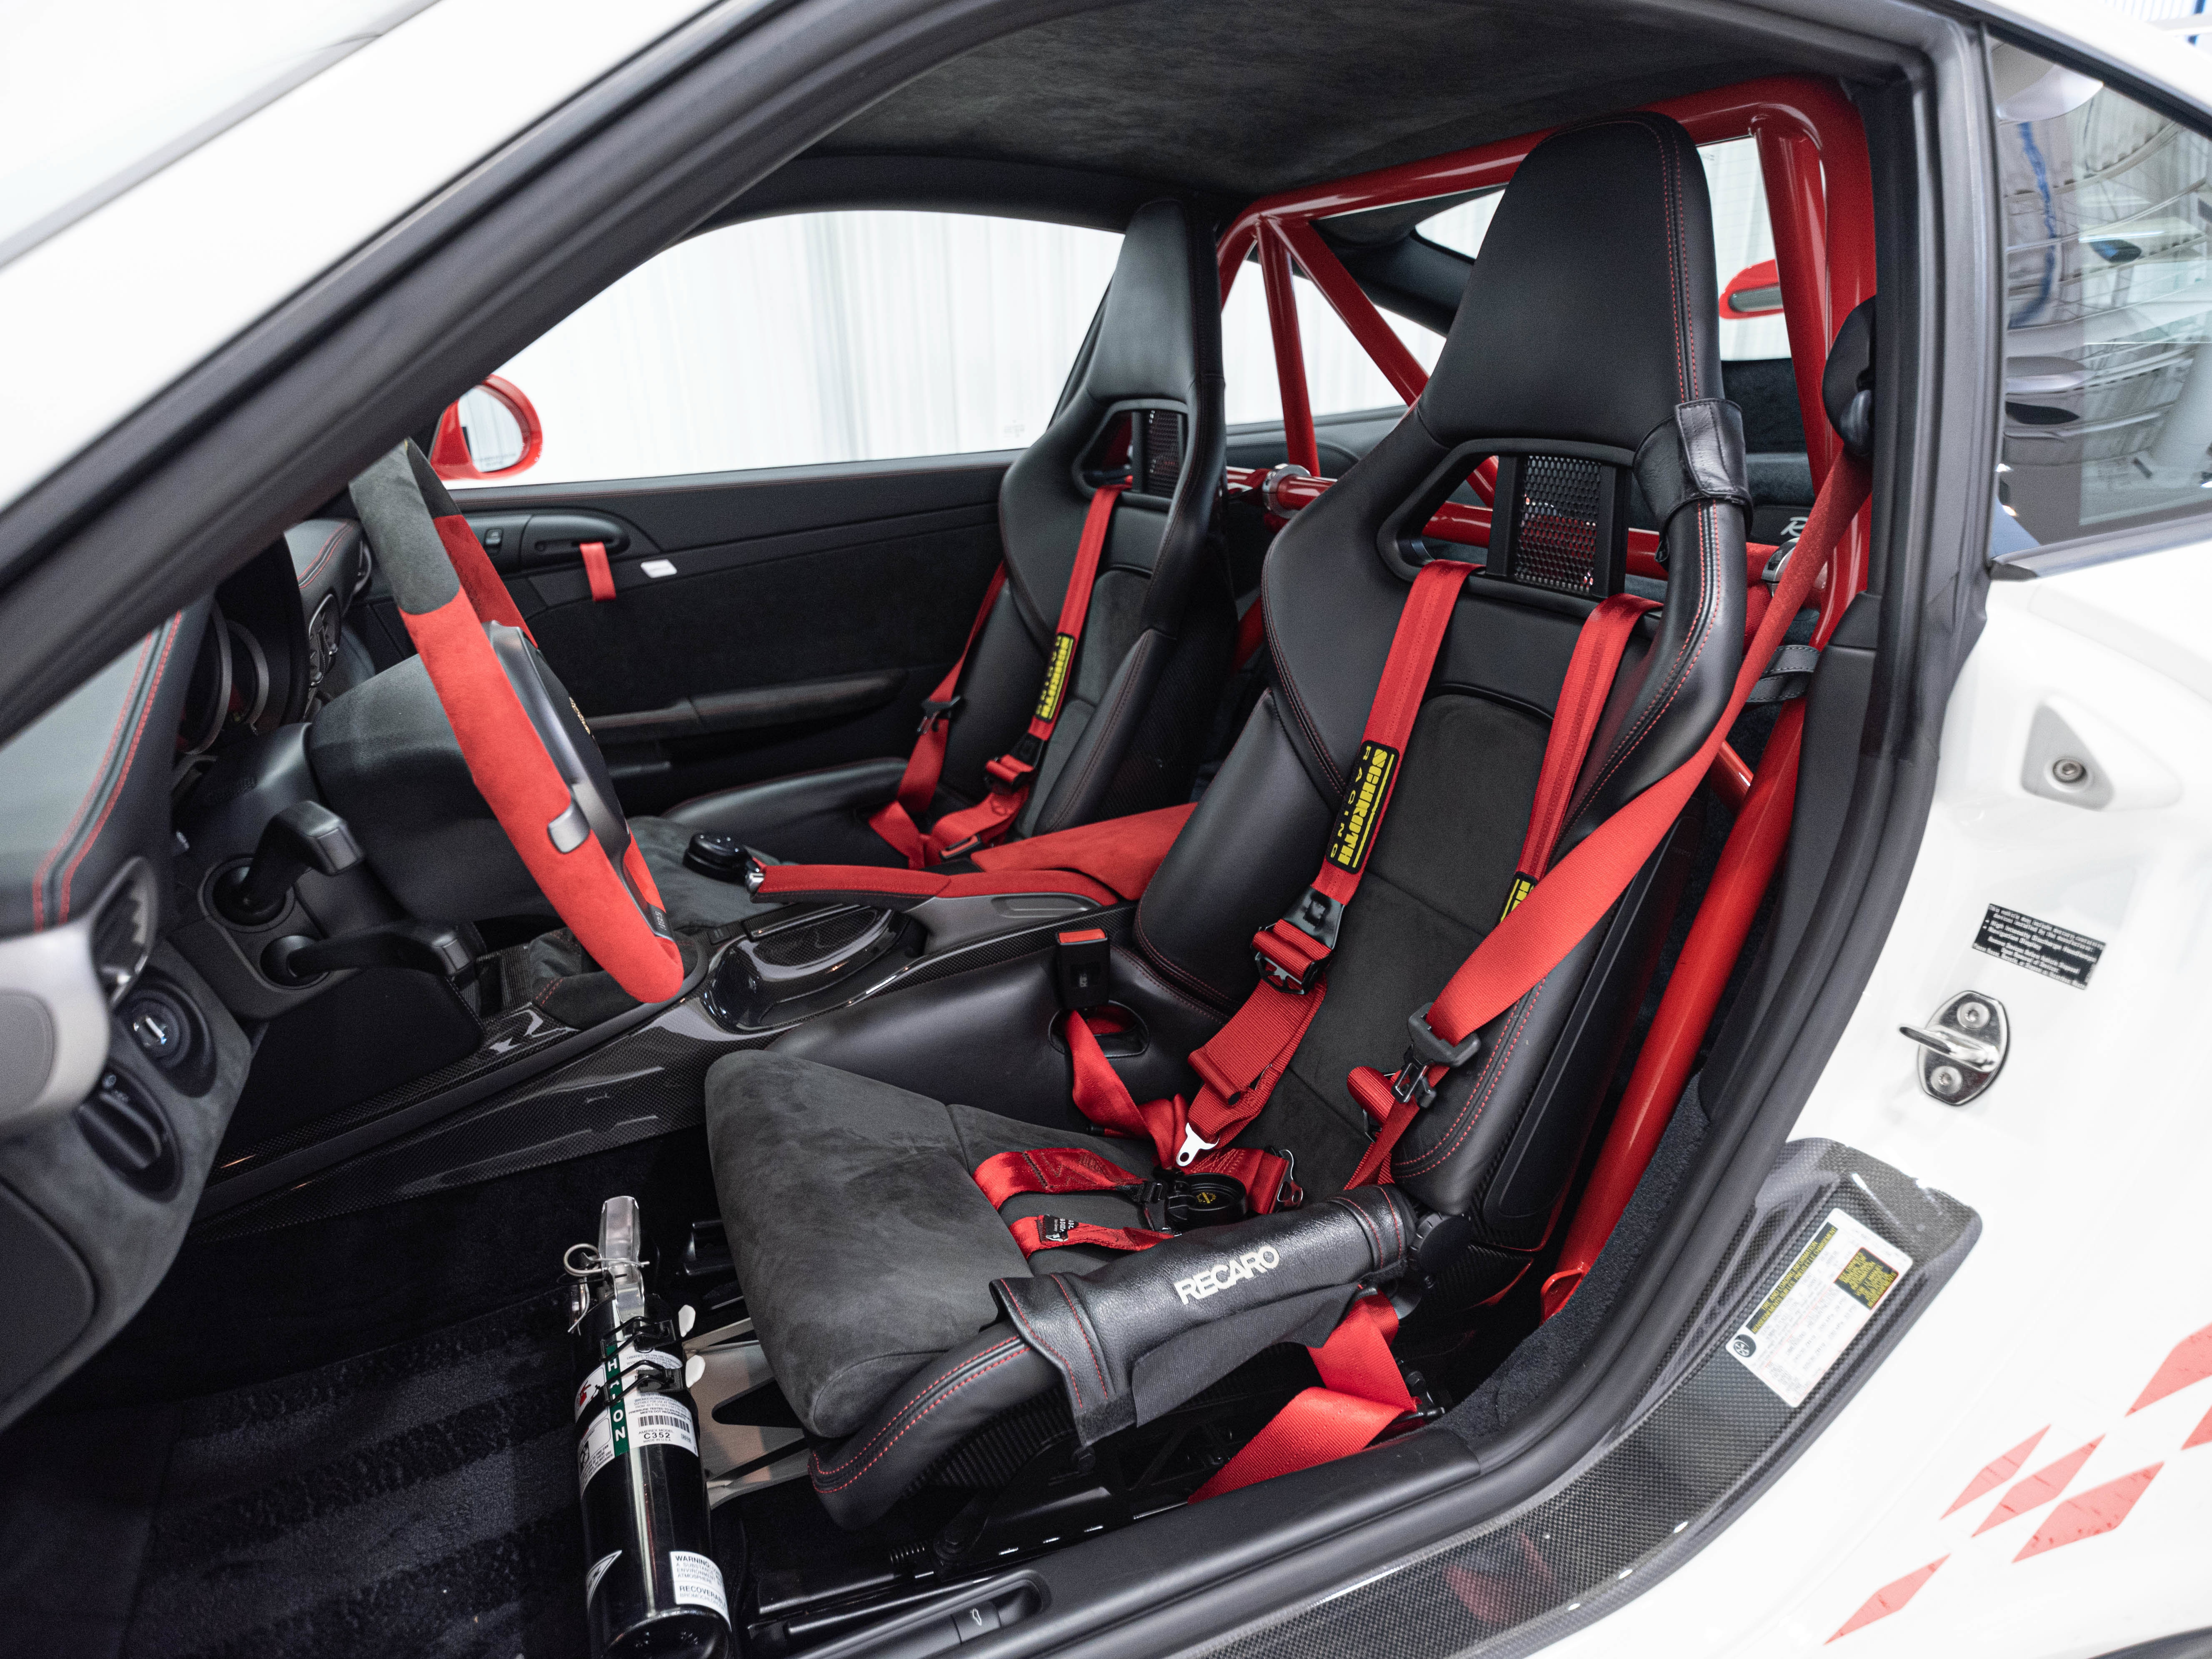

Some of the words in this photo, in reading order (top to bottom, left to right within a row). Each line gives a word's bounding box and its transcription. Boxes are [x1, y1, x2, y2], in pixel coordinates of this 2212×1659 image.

[1330, 746, 1371, 858] RACING
[1337, 748, 1388, 866] SCHROTH
[1174, 1246, 1280, 1305] RECARO
[1760, 1300, 1771, 1311] TIRE
[1768, 1289, 1780, 1302] AND
[1776, 1269, 1795, 1291] LOADING
[1792, 1240, 1819, 1272] INFORMATION
